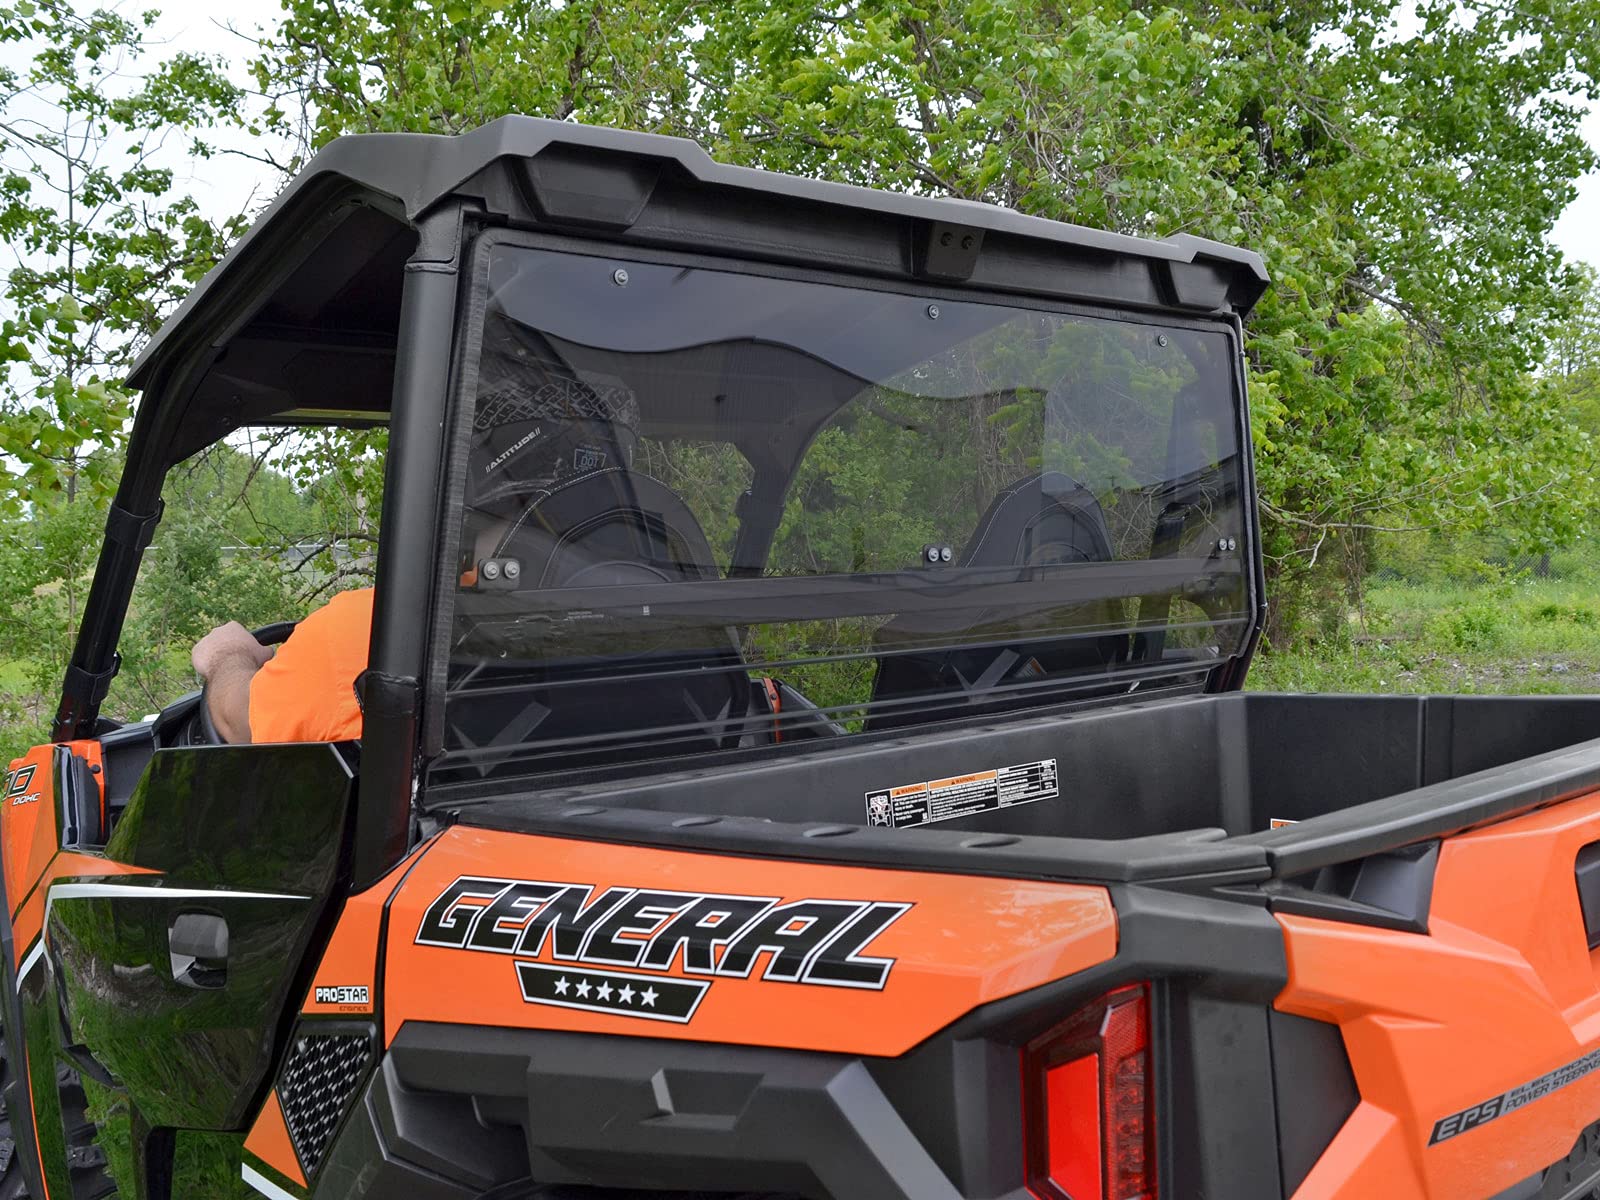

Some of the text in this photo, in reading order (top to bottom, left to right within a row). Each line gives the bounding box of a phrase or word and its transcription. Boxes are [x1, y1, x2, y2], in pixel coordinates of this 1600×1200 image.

[13, 792, 41, 806] DOHC
[413, 875, 918, 991] GENERAL
[315, 987, 369, 1003] PROSTAR
[1505, 1082, 1551, 1111] POWER
[1436, 1099, 1501, 1141] EPS
